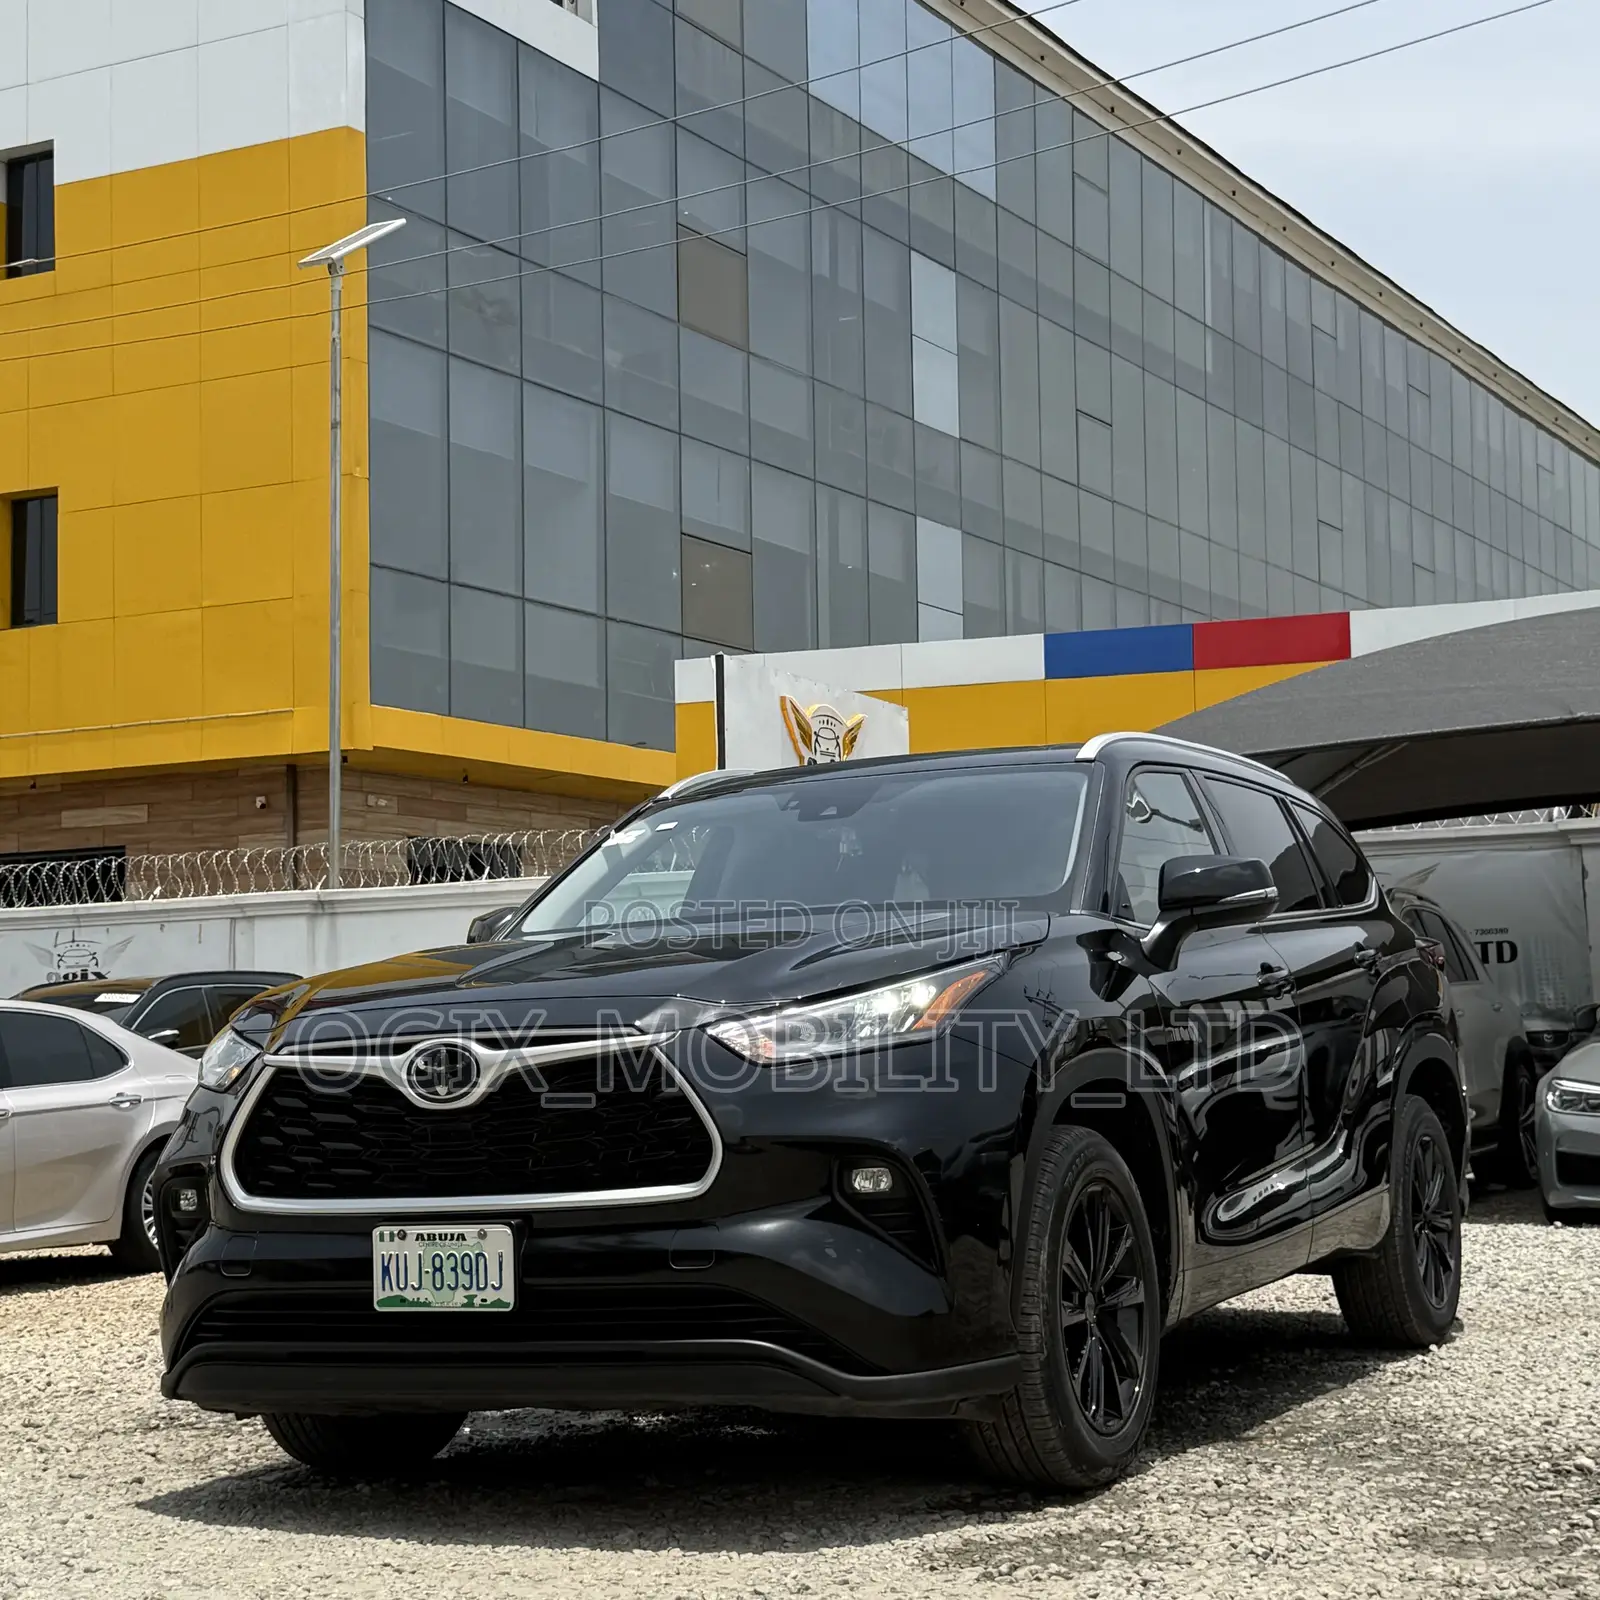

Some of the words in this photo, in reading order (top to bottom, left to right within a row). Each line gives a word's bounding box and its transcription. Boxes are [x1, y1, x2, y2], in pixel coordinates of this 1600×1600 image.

[1473, 940, 1518, 965] TD
[414, 1232, 468, 1242] ABUJA
[380, 1251, 504, 1292] KUJ-839DJ
